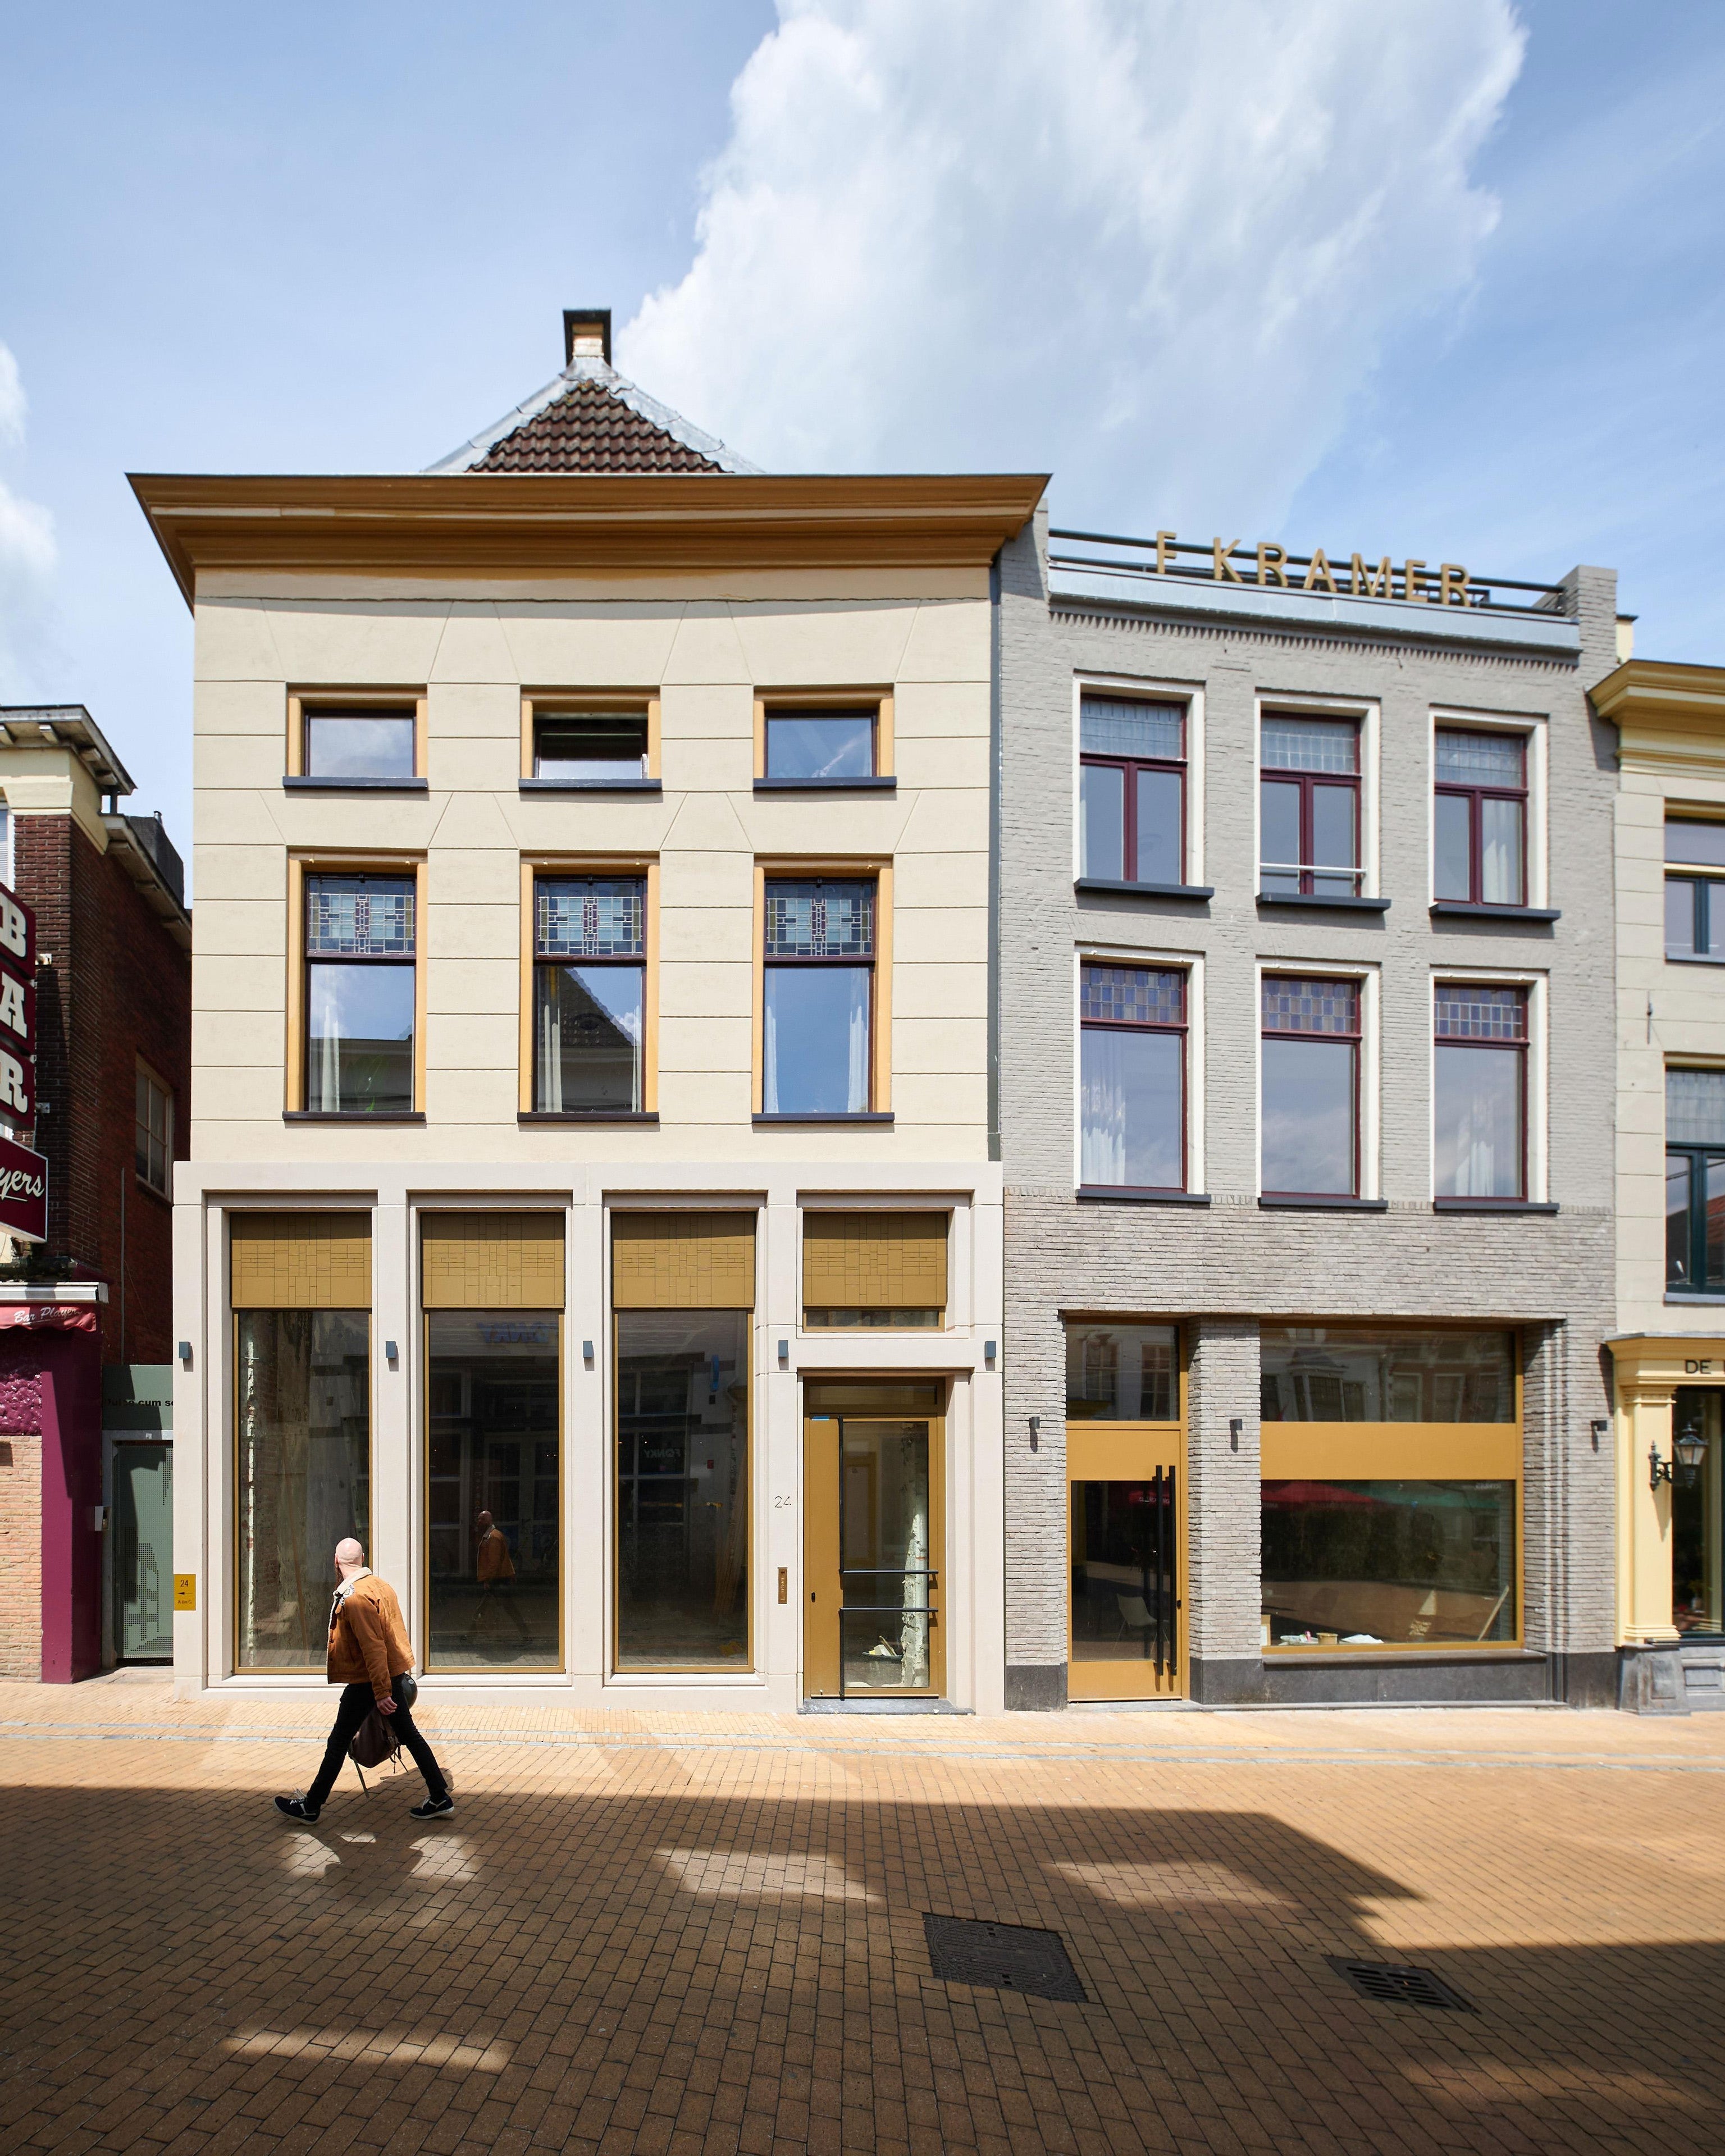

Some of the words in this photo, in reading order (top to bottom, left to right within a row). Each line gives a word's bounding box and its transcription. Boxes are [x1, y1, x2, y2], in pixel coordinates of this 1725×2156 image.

[1156, 530, 1177, 574] F
[1213, 536, 1471, 607] KRAMER
[0, 891, 28, 1113] BAR
[13, 1310, 36, 1323] Bar
[1685, 1359, 1712, 1374] DE
[774, 1496, 792, 1508] 24
